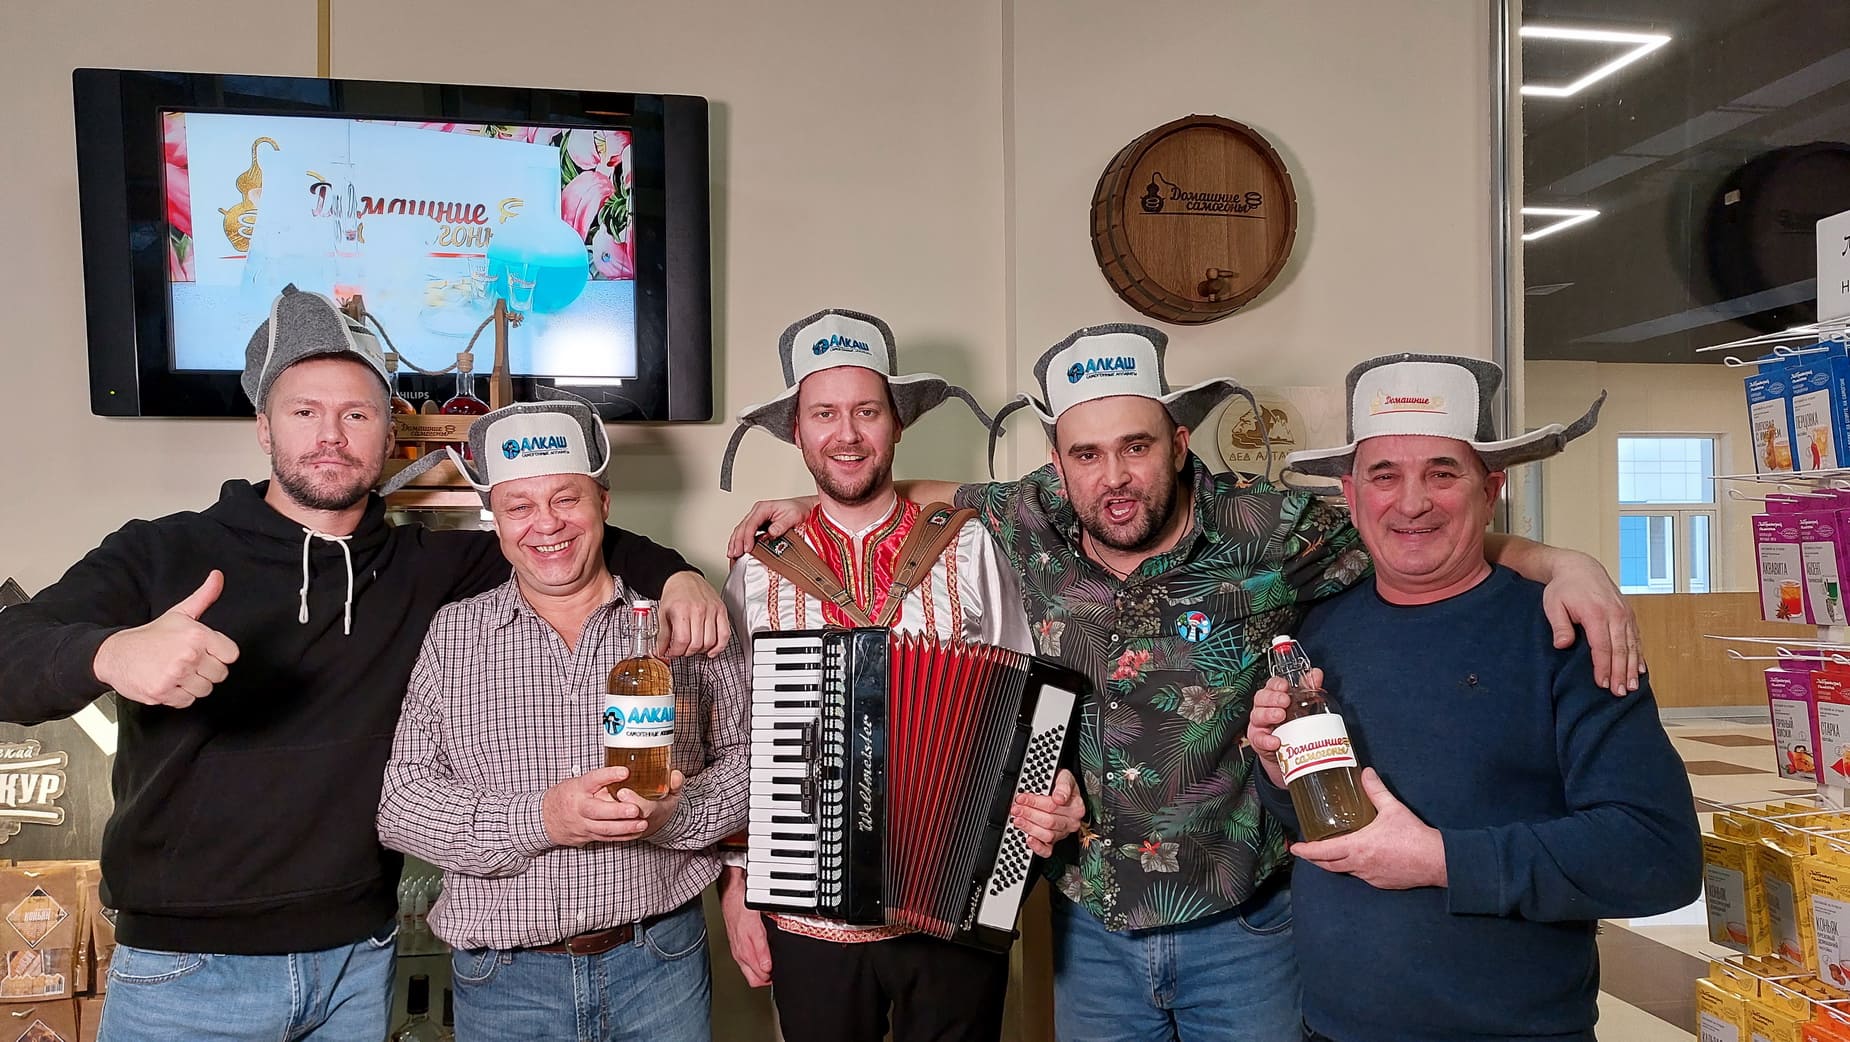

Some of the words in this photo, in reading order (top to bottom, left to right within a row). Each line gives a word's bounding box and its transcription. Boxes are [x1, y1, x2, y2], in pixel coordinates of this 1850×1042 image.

[1170, 186, 1240, 203] Домашние
[1186, 200, 1250, 213] самогоны
[829, 334, 870, 351] АЛКАШ
[1085, 356, 1136, 372] АЛКАШ
[1384, 395, 1431, 405] Домашние
[521, 435, 568, 451] АЛКАШ
[1285, 736, 1344, 759] Домашние
[1294, 744, 1349, 765] самогоны
[858, 713, 875, 832] Weltmeister
